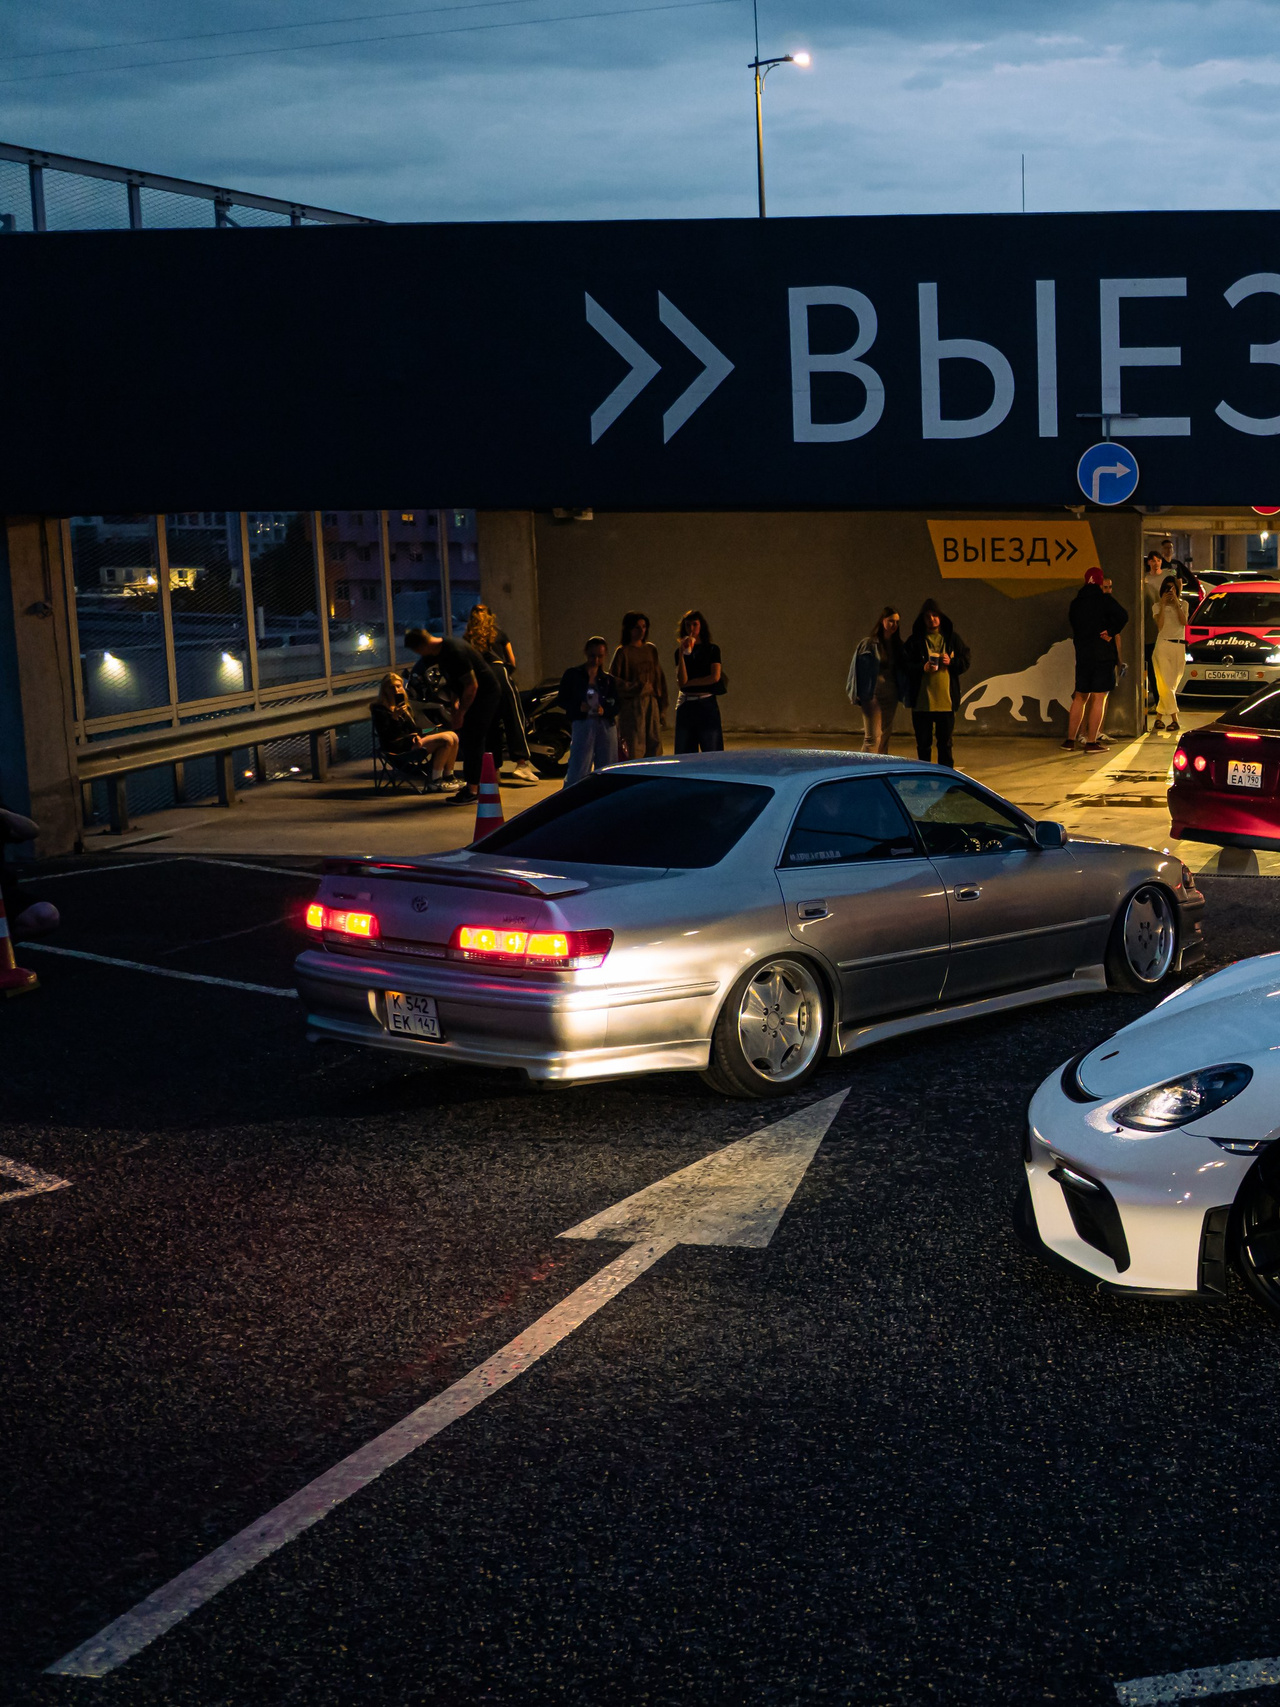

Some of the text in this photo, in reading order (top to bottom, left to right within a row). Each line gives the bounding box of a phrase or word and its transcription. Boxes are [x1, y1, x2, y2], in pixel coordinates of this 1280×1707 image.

[943, 537, 1051, 567] ВЫЕЗД
[1207, 636, 1257, 648] Marlboro
[1241, 763, 1257, 774] 392
[1247, 776, 1259, 784] 790
[405, 995, 430, 1014] 542
[417, 1017, 436, 1031] 147
